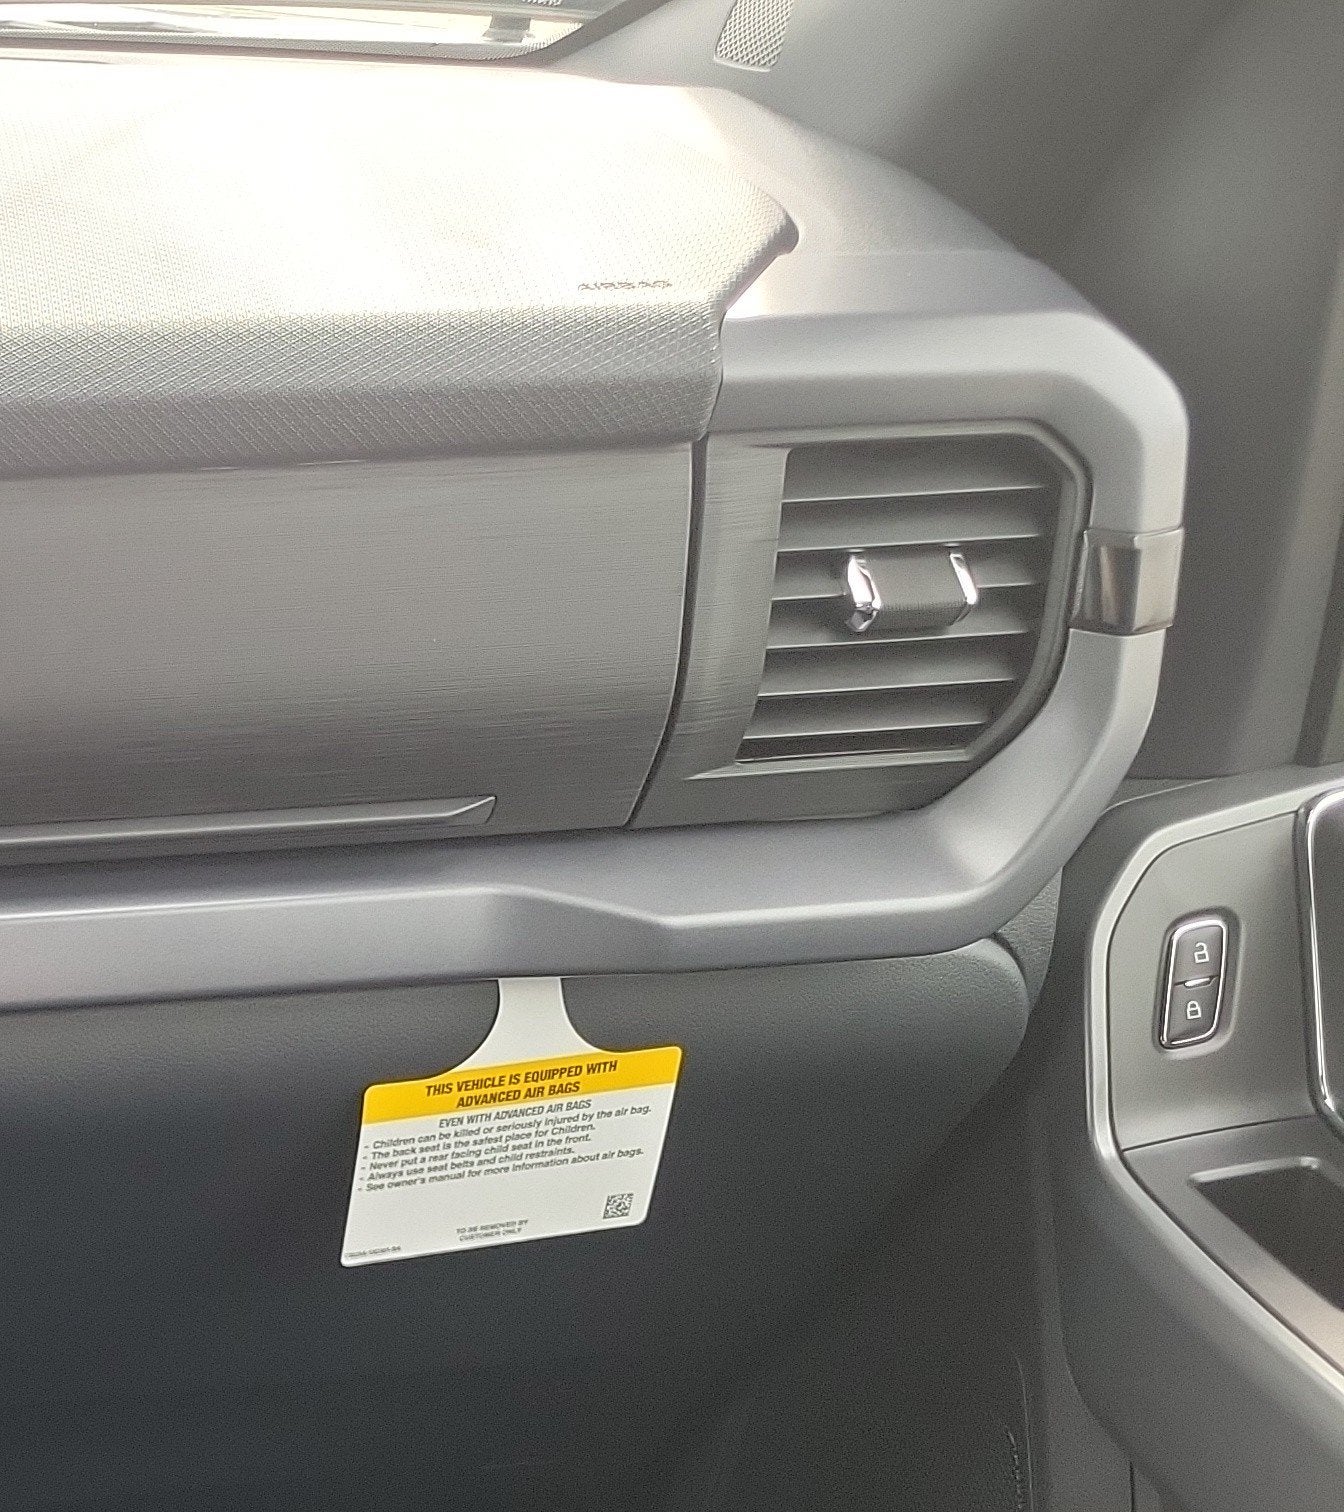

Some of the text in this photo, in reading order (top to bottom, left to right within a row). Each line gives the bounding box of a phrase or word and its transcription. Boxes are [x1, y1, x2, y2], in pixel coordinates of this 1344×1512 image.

[425, 1060, 618, 1097] THIS VEHICLE IS EQUIPPED WITH
[456, 1081, 581, 1109] ADVANCED AIR BAGS
[373, 1137, 415, 1149] Children
[418, 1134, 436, 1144] can
[438, 1131, 451, 1140] be
[453, 1126, 480, 1138] killed
[482, 1126, 494, 1135] or
[496, 1118, 542, 1132] seriously
[581, 1112, 595, 1122] by
[596, 1110, 613, 1120] the
[614, 1107, 628, 1117] air
[630, 1105, 652, 1116] bag.
[439, 1099, 592, 1129] EVEN WITH ADVANCED AIR BAGS
[369, 1160, 398, 1171] Never
[400, 1157, 418, 1168] put
[428, 1153, 448, 1162] rear
[450, 1148, 481, 1159] facing
[484, 1144, 509, 1155] child
[511, 1141, 533, 1152] seat
[534, 1139, 544, 1148] in
[546, 1137, 562, 1146] the
[565, 1133, 591, 1144] front.
[371, 1123, 596, 1160] The back seat is the safest place for Children.
[365, 1182, 385, 1192] See
[387, 1177, 426, 1189] owner's
[428, 1172, 466, 1183] manual
[467, 1168, 481, 1178] for
[483, 1165, 510, 1176] more
[512, 1159, 569, 1173] information
[570, 1154, 600, 1165] about
[601, 1151, 615, 1160] air
[368, 1170, 404, 1181] Always
[406, 1167, 424, 1176] use
[427, 1163, 448, 1173] seat
[450, 1159, 475, 1170] belts
[476, 1156, 496, 1166] and
[498, 1151, 523, 1163] child
